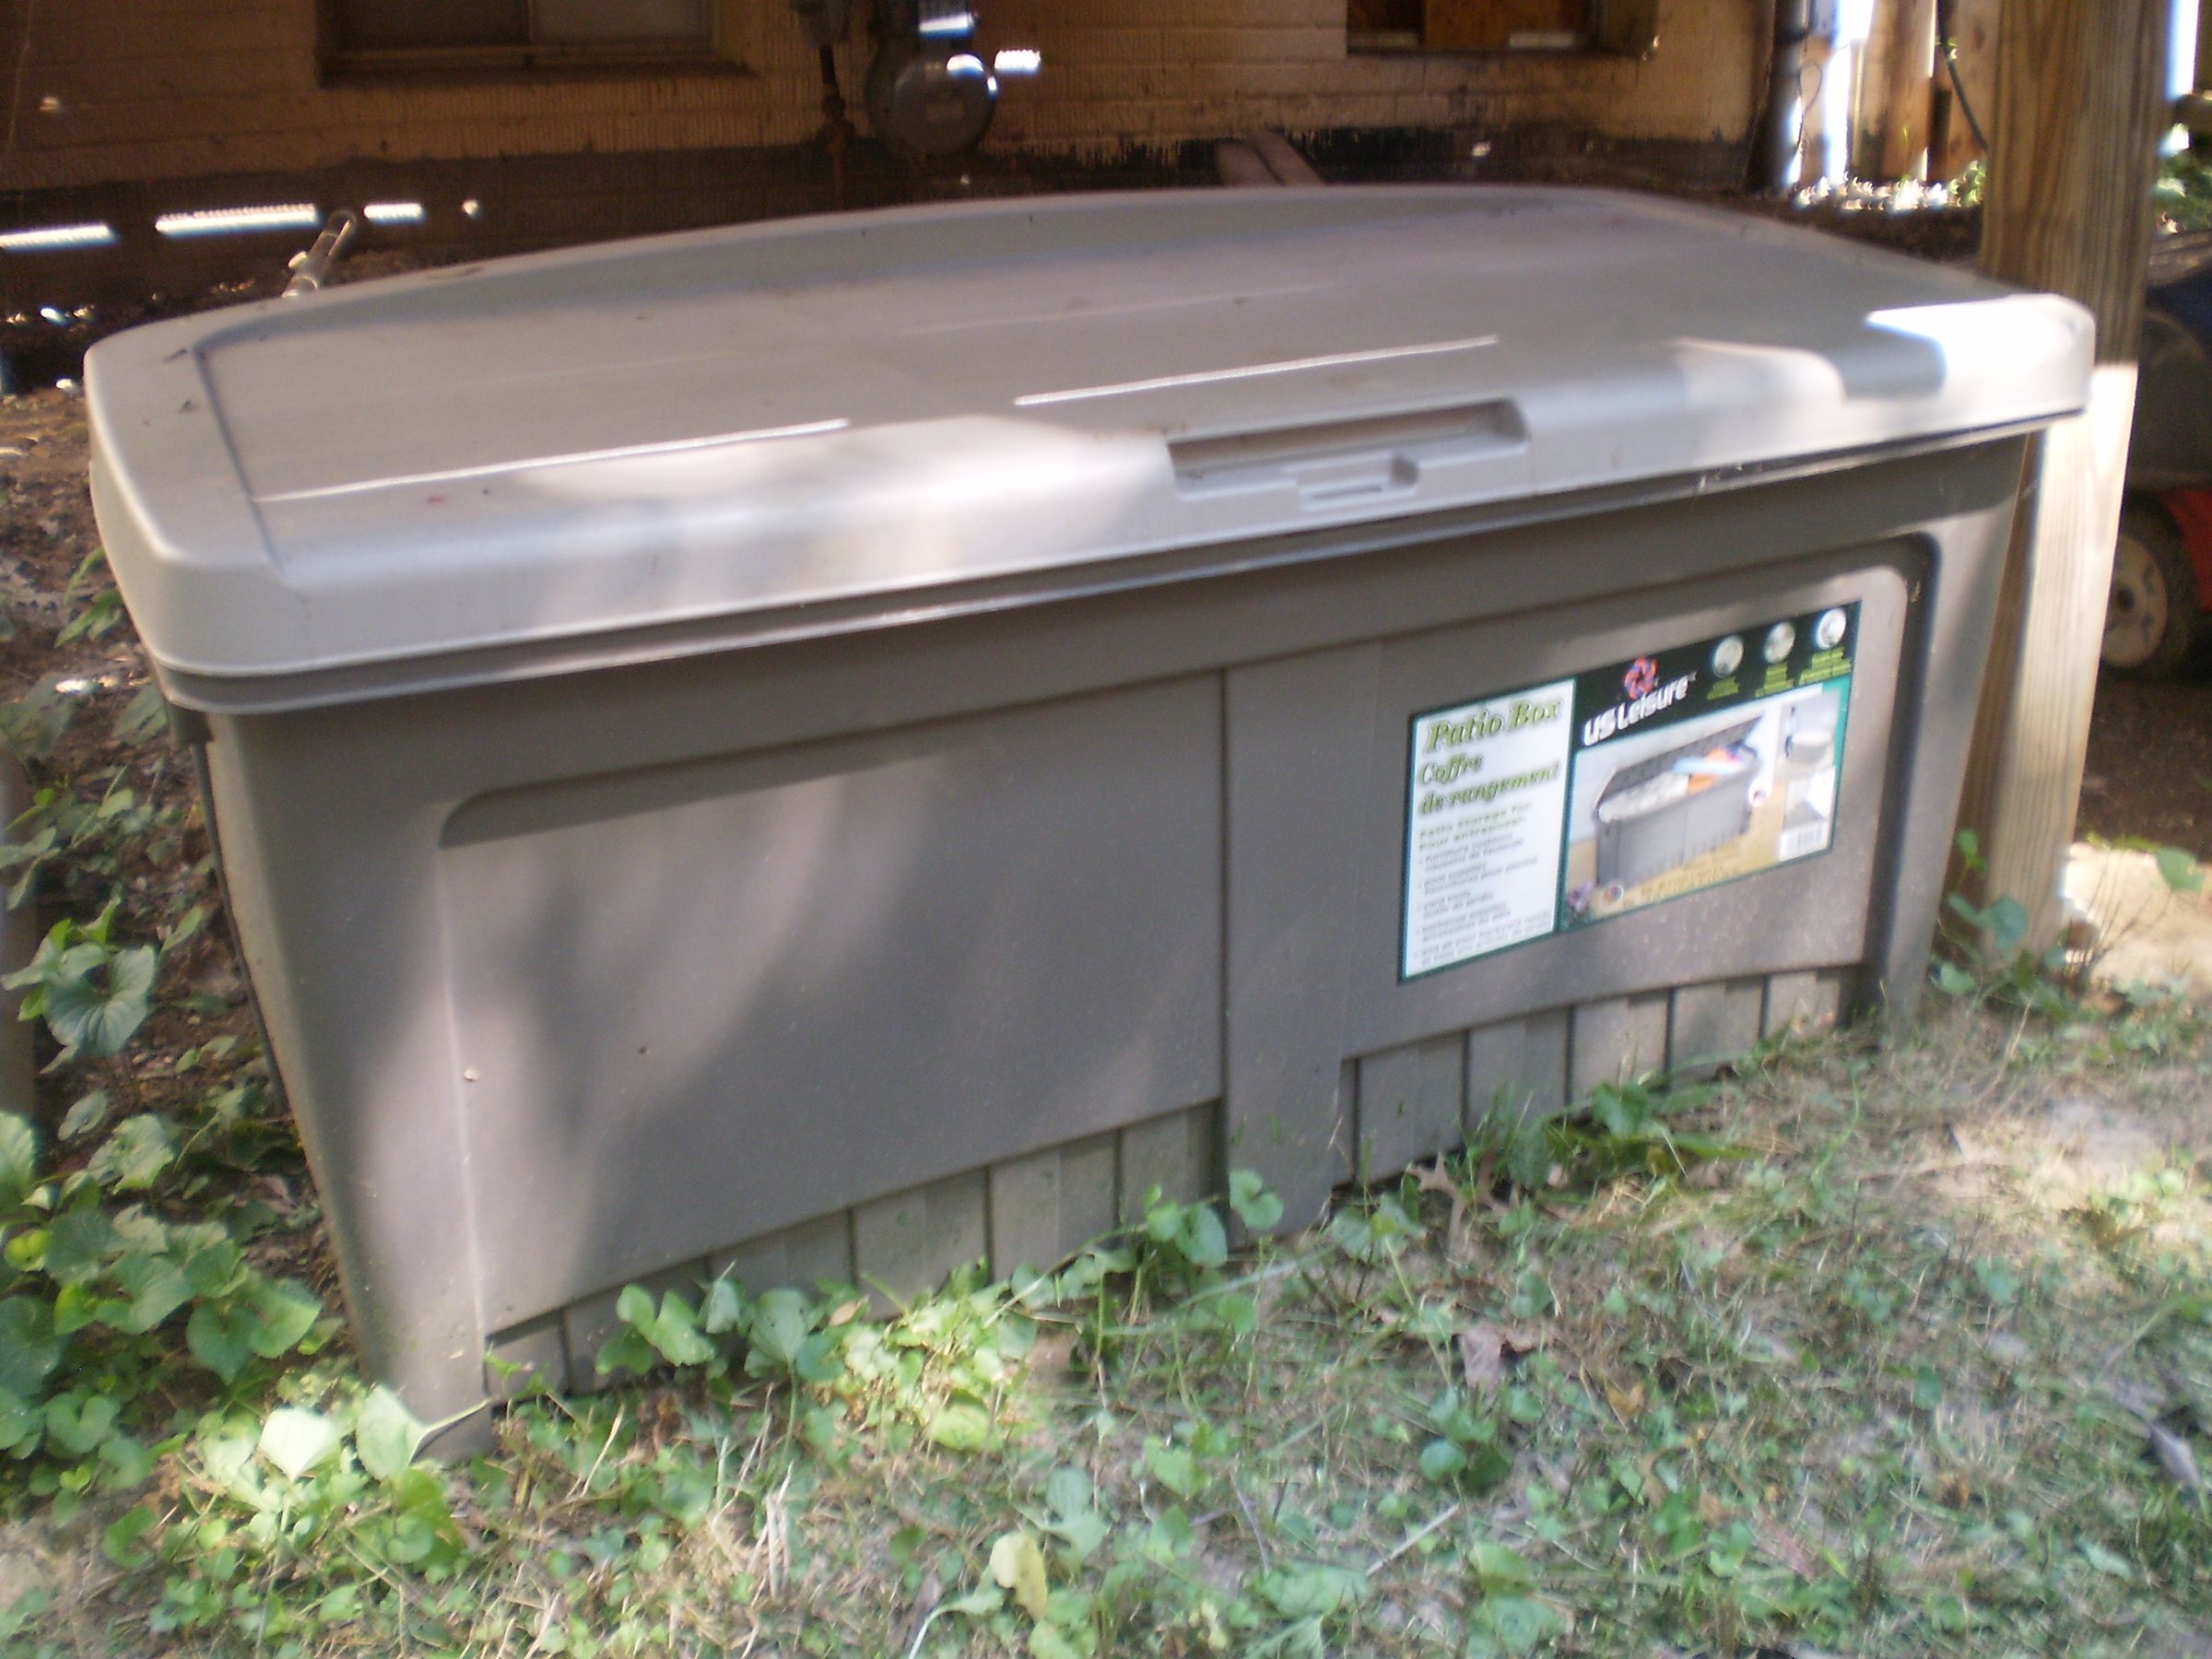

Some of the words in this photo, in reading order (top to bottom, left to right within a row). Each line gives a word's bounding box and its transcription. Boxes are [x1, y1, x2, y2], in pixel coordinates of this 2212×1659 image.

[1427, 709, 1504, 752] Patio
[1507, 700, 1562, 730] Box
[1583, 707, 1617, 747] US
[1618, 675, 1688, 730] Leisure
[1420, 753, 1482, 784] Coffre
[1420, 792, 1445, 815] de
